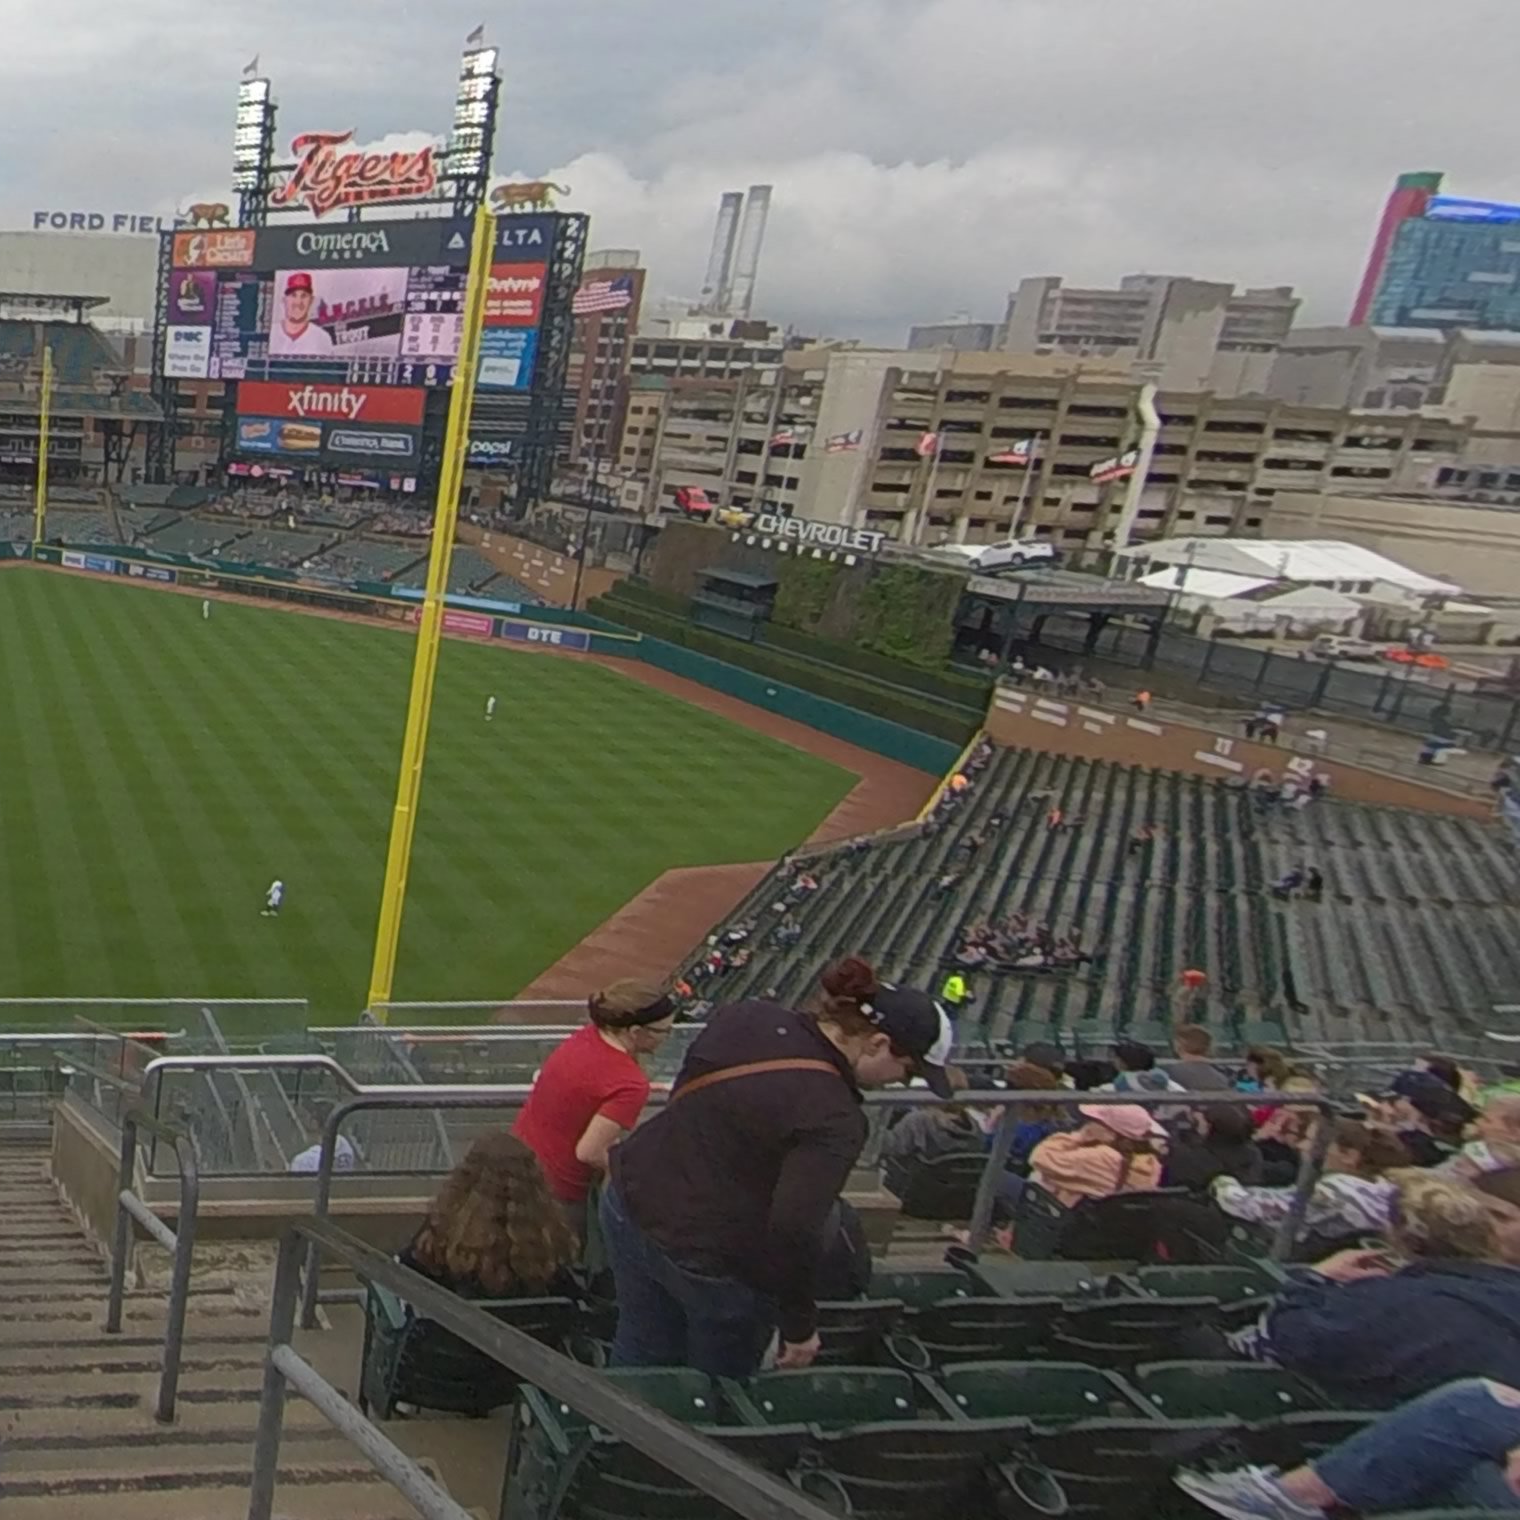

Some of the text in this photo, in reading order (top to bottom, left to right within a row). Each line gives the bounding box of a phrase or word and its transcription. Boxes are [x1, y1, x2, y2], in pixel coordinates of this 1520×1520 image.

[268, 130, 437, 218] Tigers
[33, 211, 105, 230] FORD
[288, 384, 367, 419] xfinity
[757, 513, 885, 552] CHEVROLET
